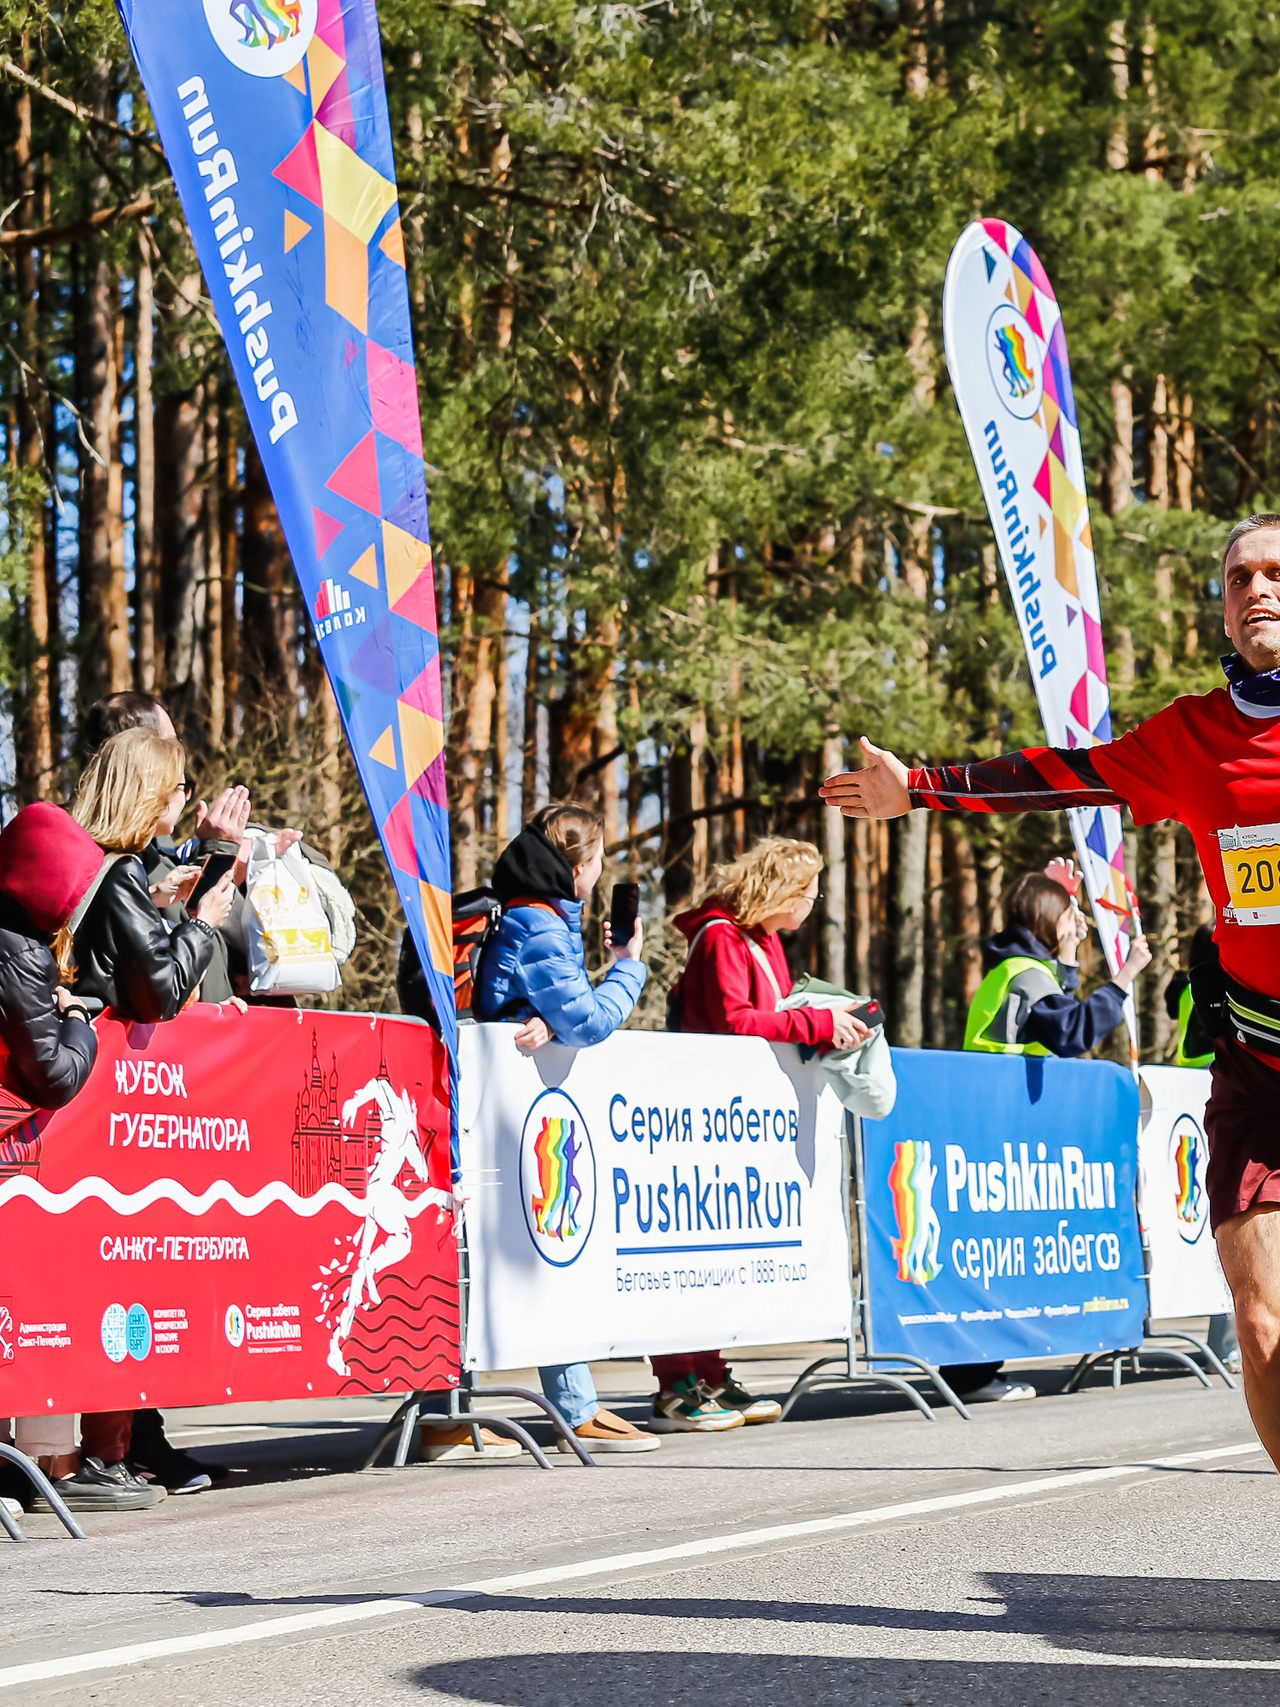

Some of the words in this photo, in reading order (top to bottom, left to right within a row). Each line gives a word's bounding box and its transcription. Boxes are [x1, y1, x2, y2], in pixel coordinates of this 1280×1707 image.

[114, 1059, 187, 1099] КУБОК
[109, 1112, 250, 1152] ГУБЕРНАТОРА
[609, 1093, 693, 1154] Серия
[702, 1095, 800, 1143] забегов
[945, 1141, 1117, 1213] PushkinRun
[612, 1164, 802, 1233] PushkinRun
[100, 1235, 250, 1262] САНКТ-ПЕТЕРБУРГА
[951, 1236, 1026, 1290] серия
[1033, 1219, 1121, 1275] забегов
[616, 1267, 670, 1292] Беговые
[674, 1264, 736, 1294] традиции
[739, 1265, 747, 1283] с
[750, 1259, 776, 1284] 1888
[778, 1260, 808, 1283] года
[246, 1303, 272, 1320] Серия
[246, 1321, 302, 1340] PushkinRun
